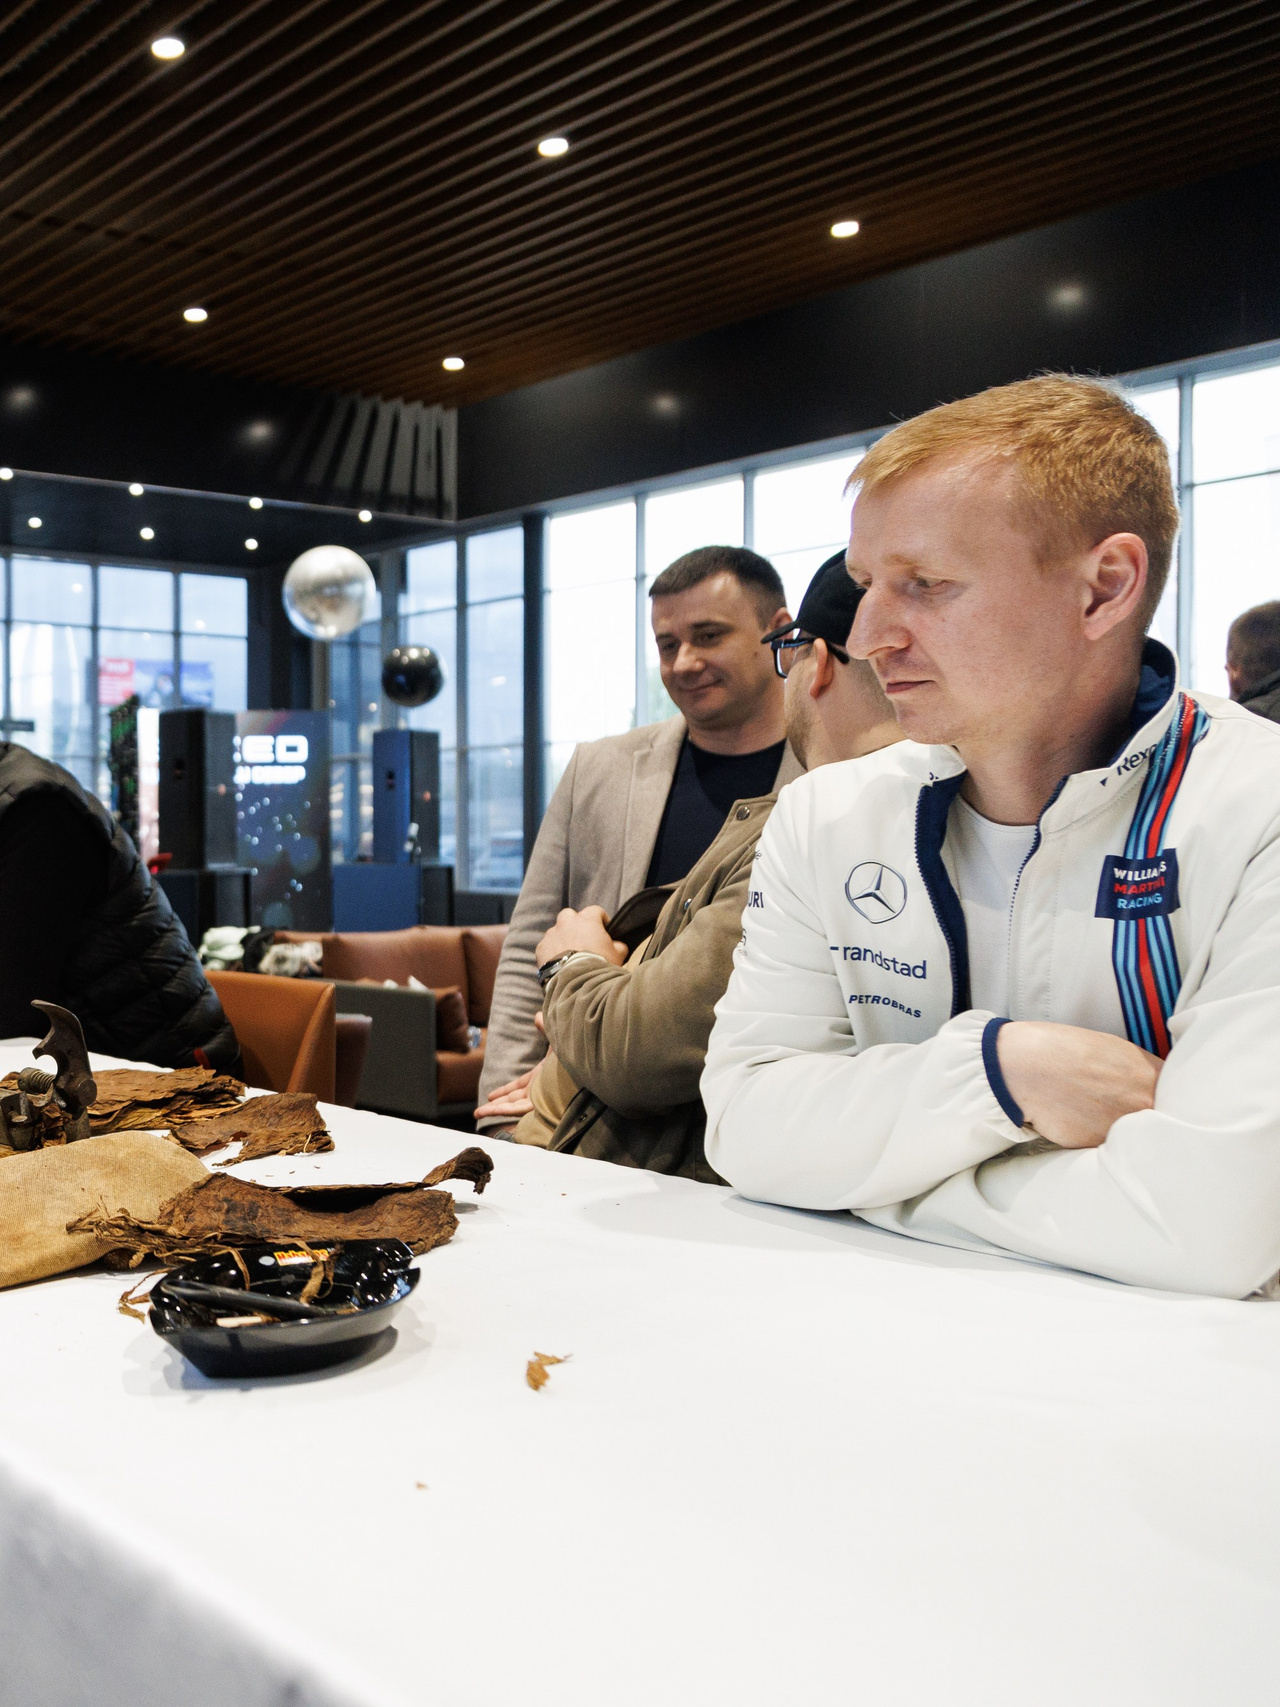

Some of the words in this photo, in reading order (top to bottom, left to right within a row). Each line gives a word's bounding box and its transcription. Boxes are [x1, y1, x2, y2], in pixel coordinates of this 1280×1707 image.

[1113, 861, 1167, 881] WILLIAS
[1116, 893, 1163, 909] RACING
[843, 946, 927, 979] randstad
[848, 994, 922, 1018] PETROBRAS
[275, 1249, 329, 1265] Habaos
